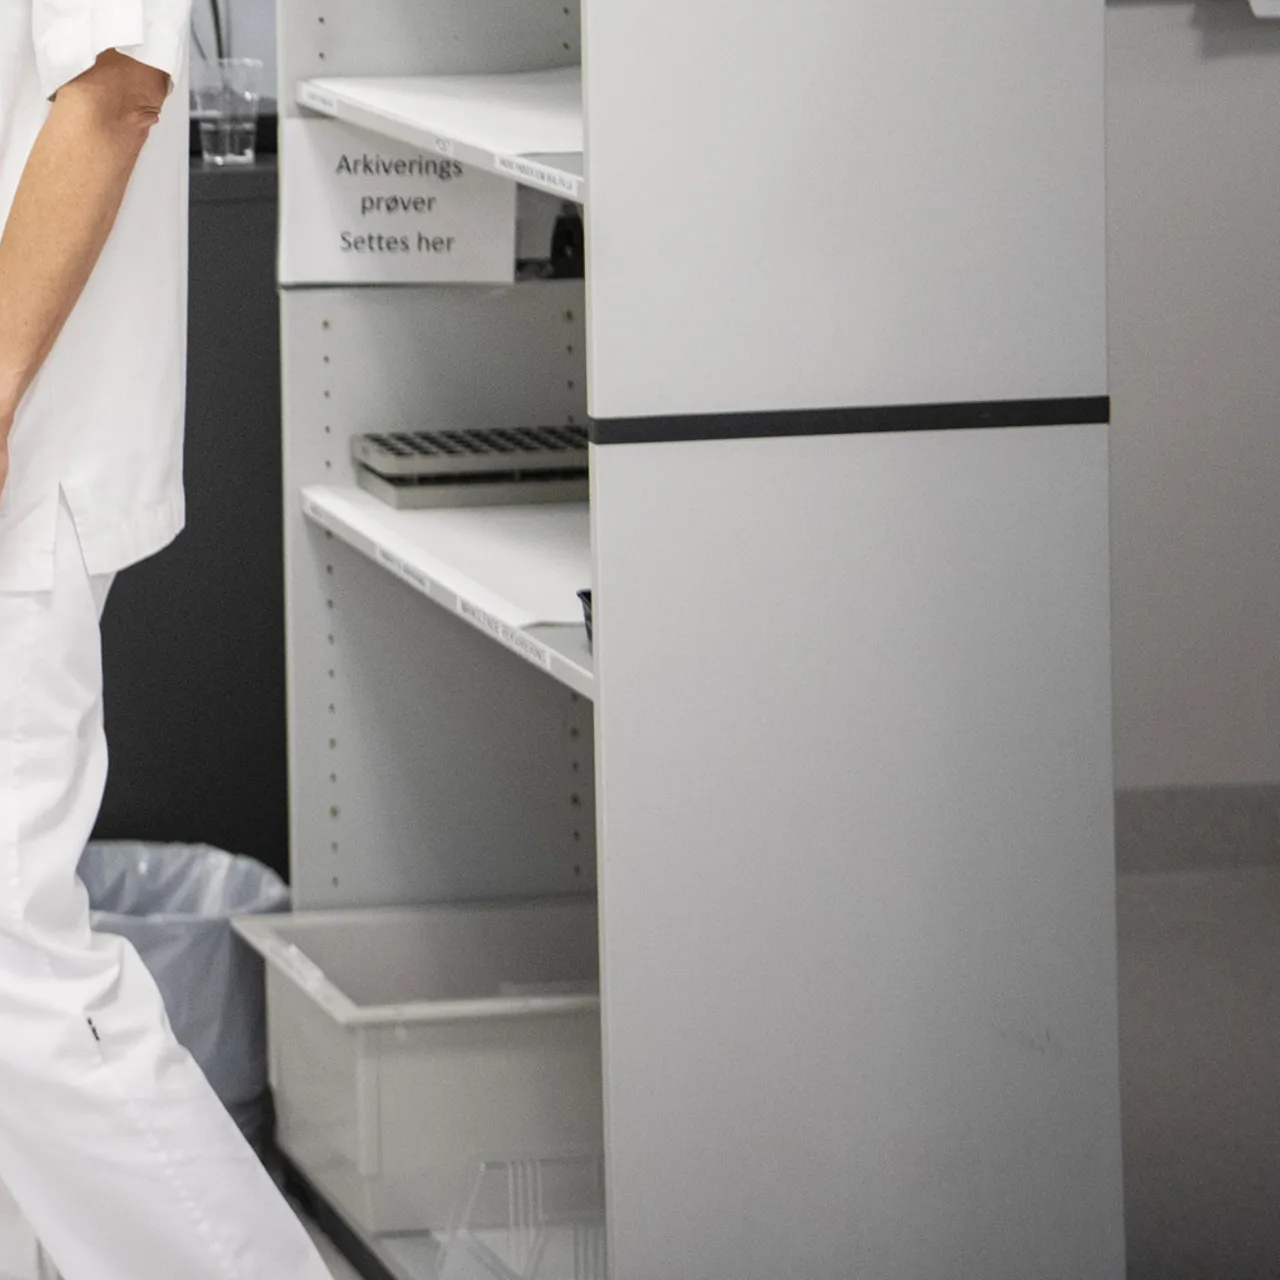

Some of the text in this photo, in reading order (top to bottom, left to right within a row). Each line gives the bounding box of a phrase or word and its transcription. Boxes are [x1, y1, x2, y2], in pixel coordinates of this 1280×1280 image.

[335, 153, 464, 181] Arkiverings
[360, 195, 437, 217] prøver
[340, 231, 455, 253] Settes her
